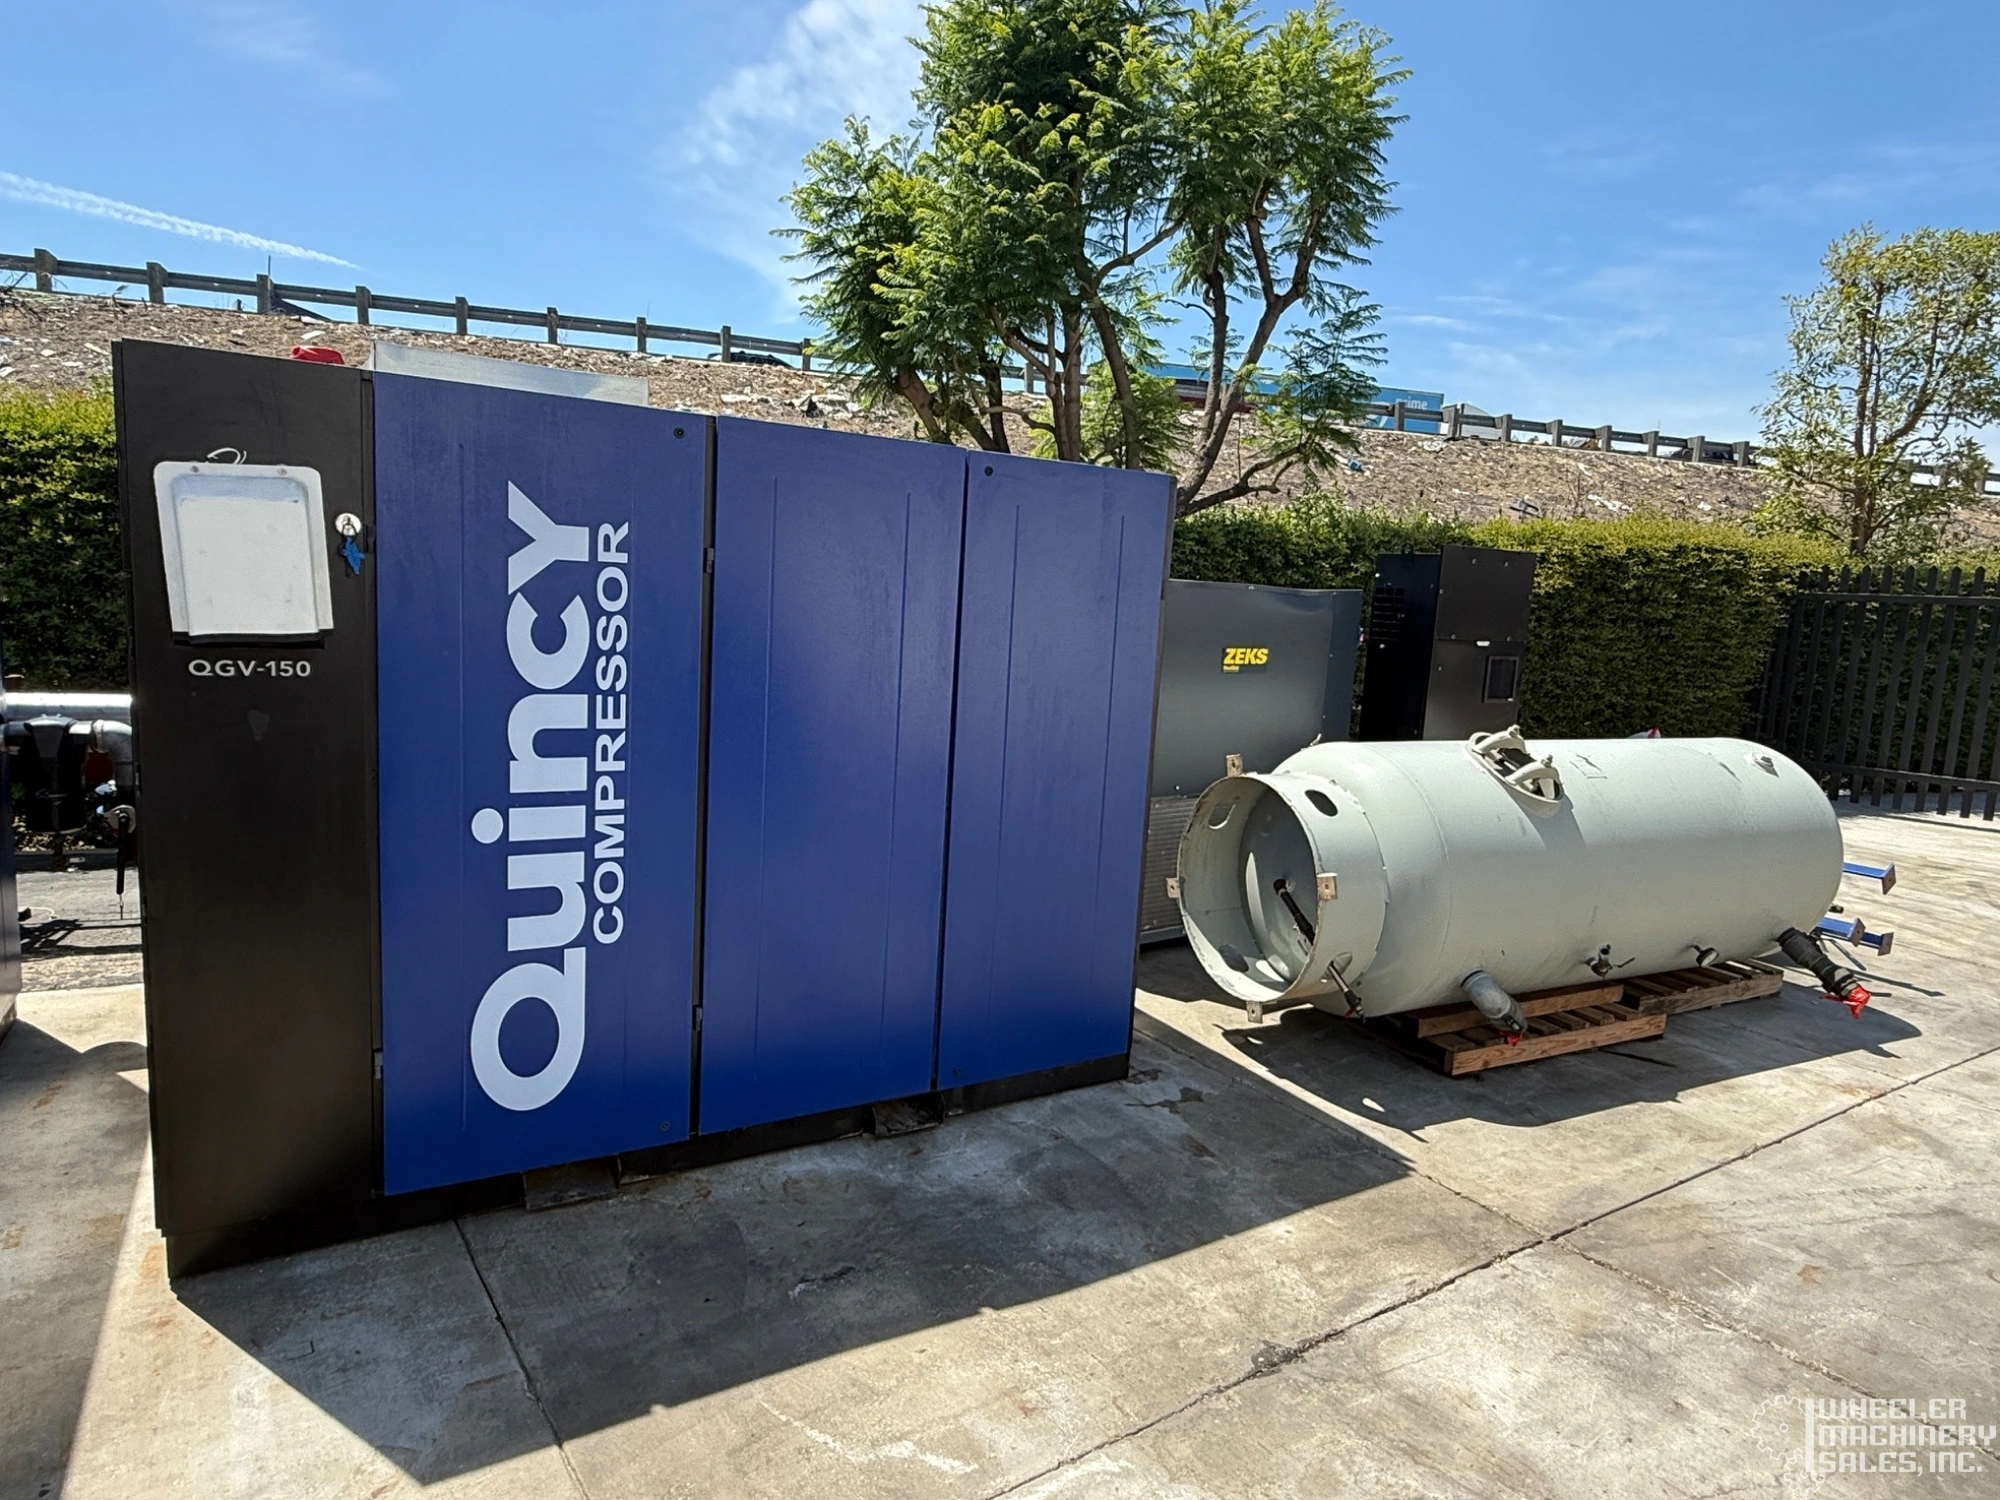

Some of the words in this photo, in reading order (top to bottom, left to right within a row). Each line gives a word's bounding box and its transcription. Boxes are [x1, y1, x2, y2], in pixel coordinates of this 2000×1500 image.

[1223, 647, 1269, 665] ZEKS
[188, 659, 311, 677] QGV-150
[593, 520, 629, 945] COMPRESSOR
